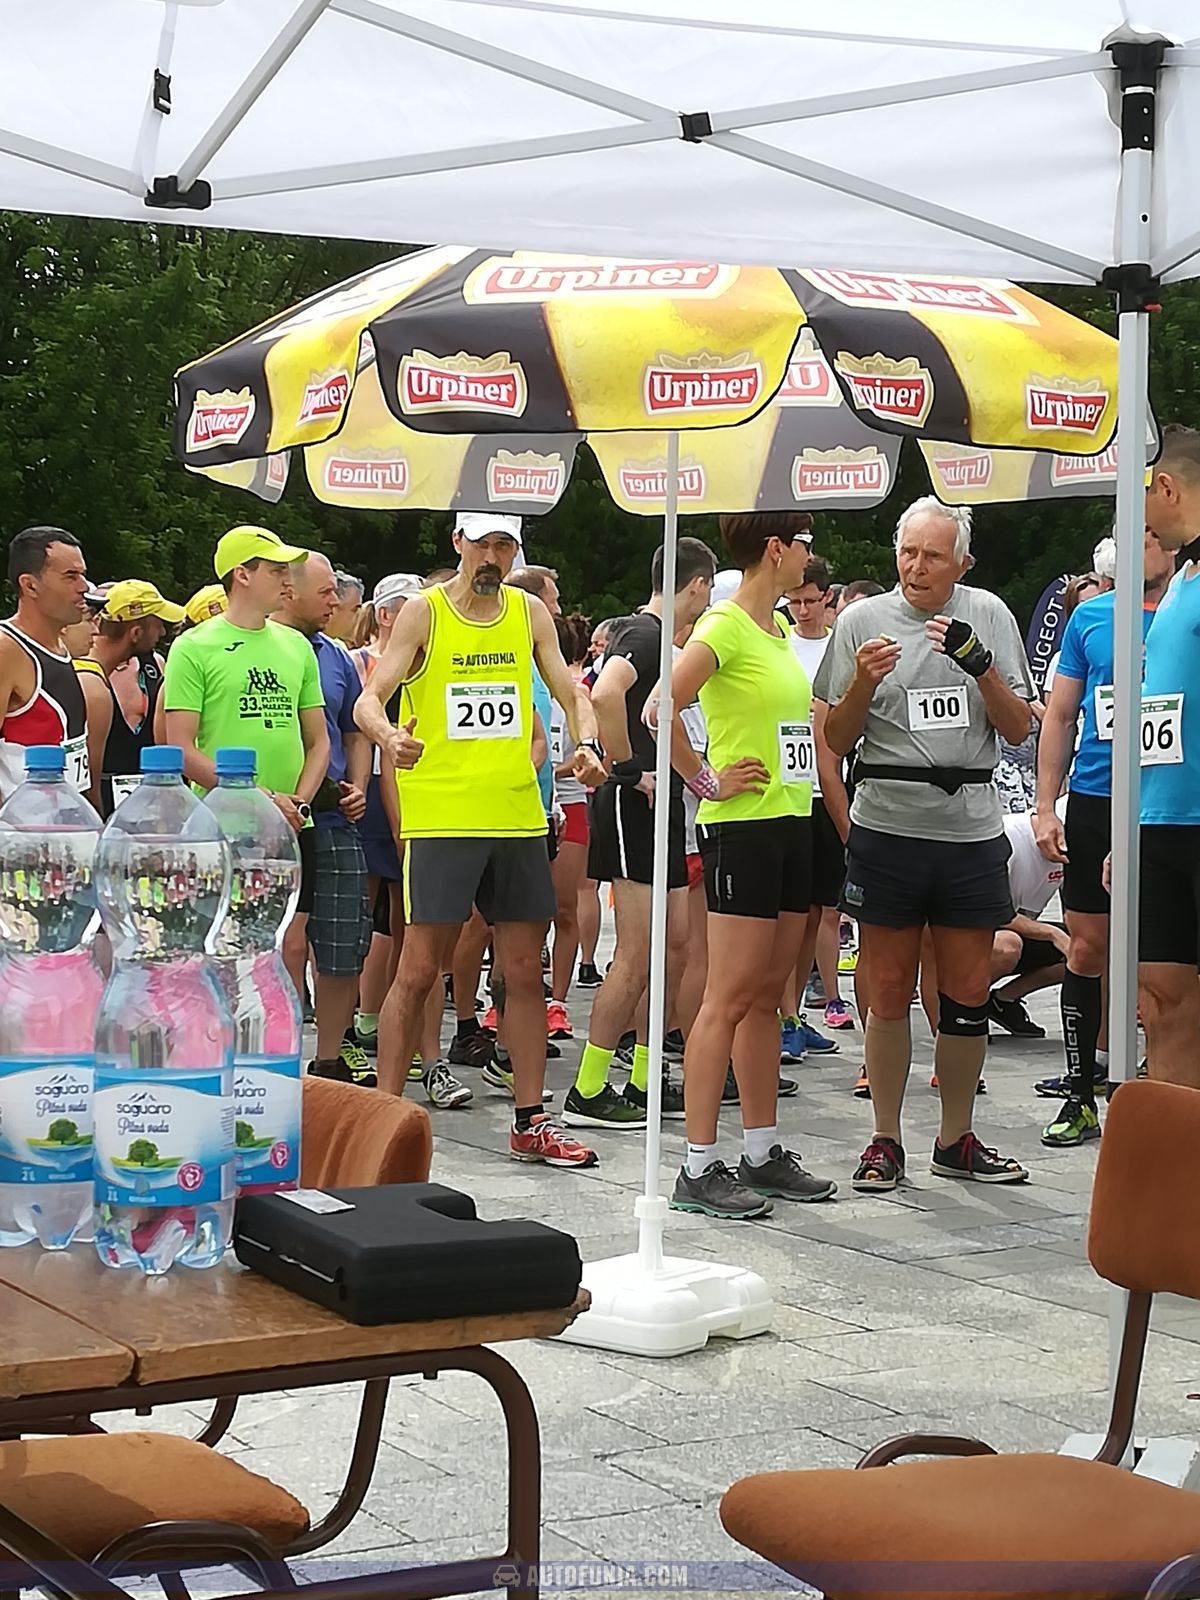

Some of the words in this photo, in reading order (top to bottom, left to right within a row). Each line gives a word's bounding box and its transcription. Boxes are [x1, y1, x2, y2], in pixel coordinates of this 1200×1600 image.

[496, 263, 716, 292] Urpiner
[409, 368, 513, 402] Urpiner
[652, 373, 754, 407] Urpiner
[1032, 392, 1102, 426] Urpiner
[1031, 597, 1063, 686] EUGEOT
[466, 653, 516, 666] AUTOFUNIA
[239, 697, 262, 711] 33.
[457, 701, 514, 727] 209
[918, 696, 960, 719] 100
[1142, 718, 1173, 751] 06
[1063, 1005, 1083, 1078] kalenji
[35, 1084, 89, 1098] saguaro
[116, 1103, 171, 1117] saguaro
